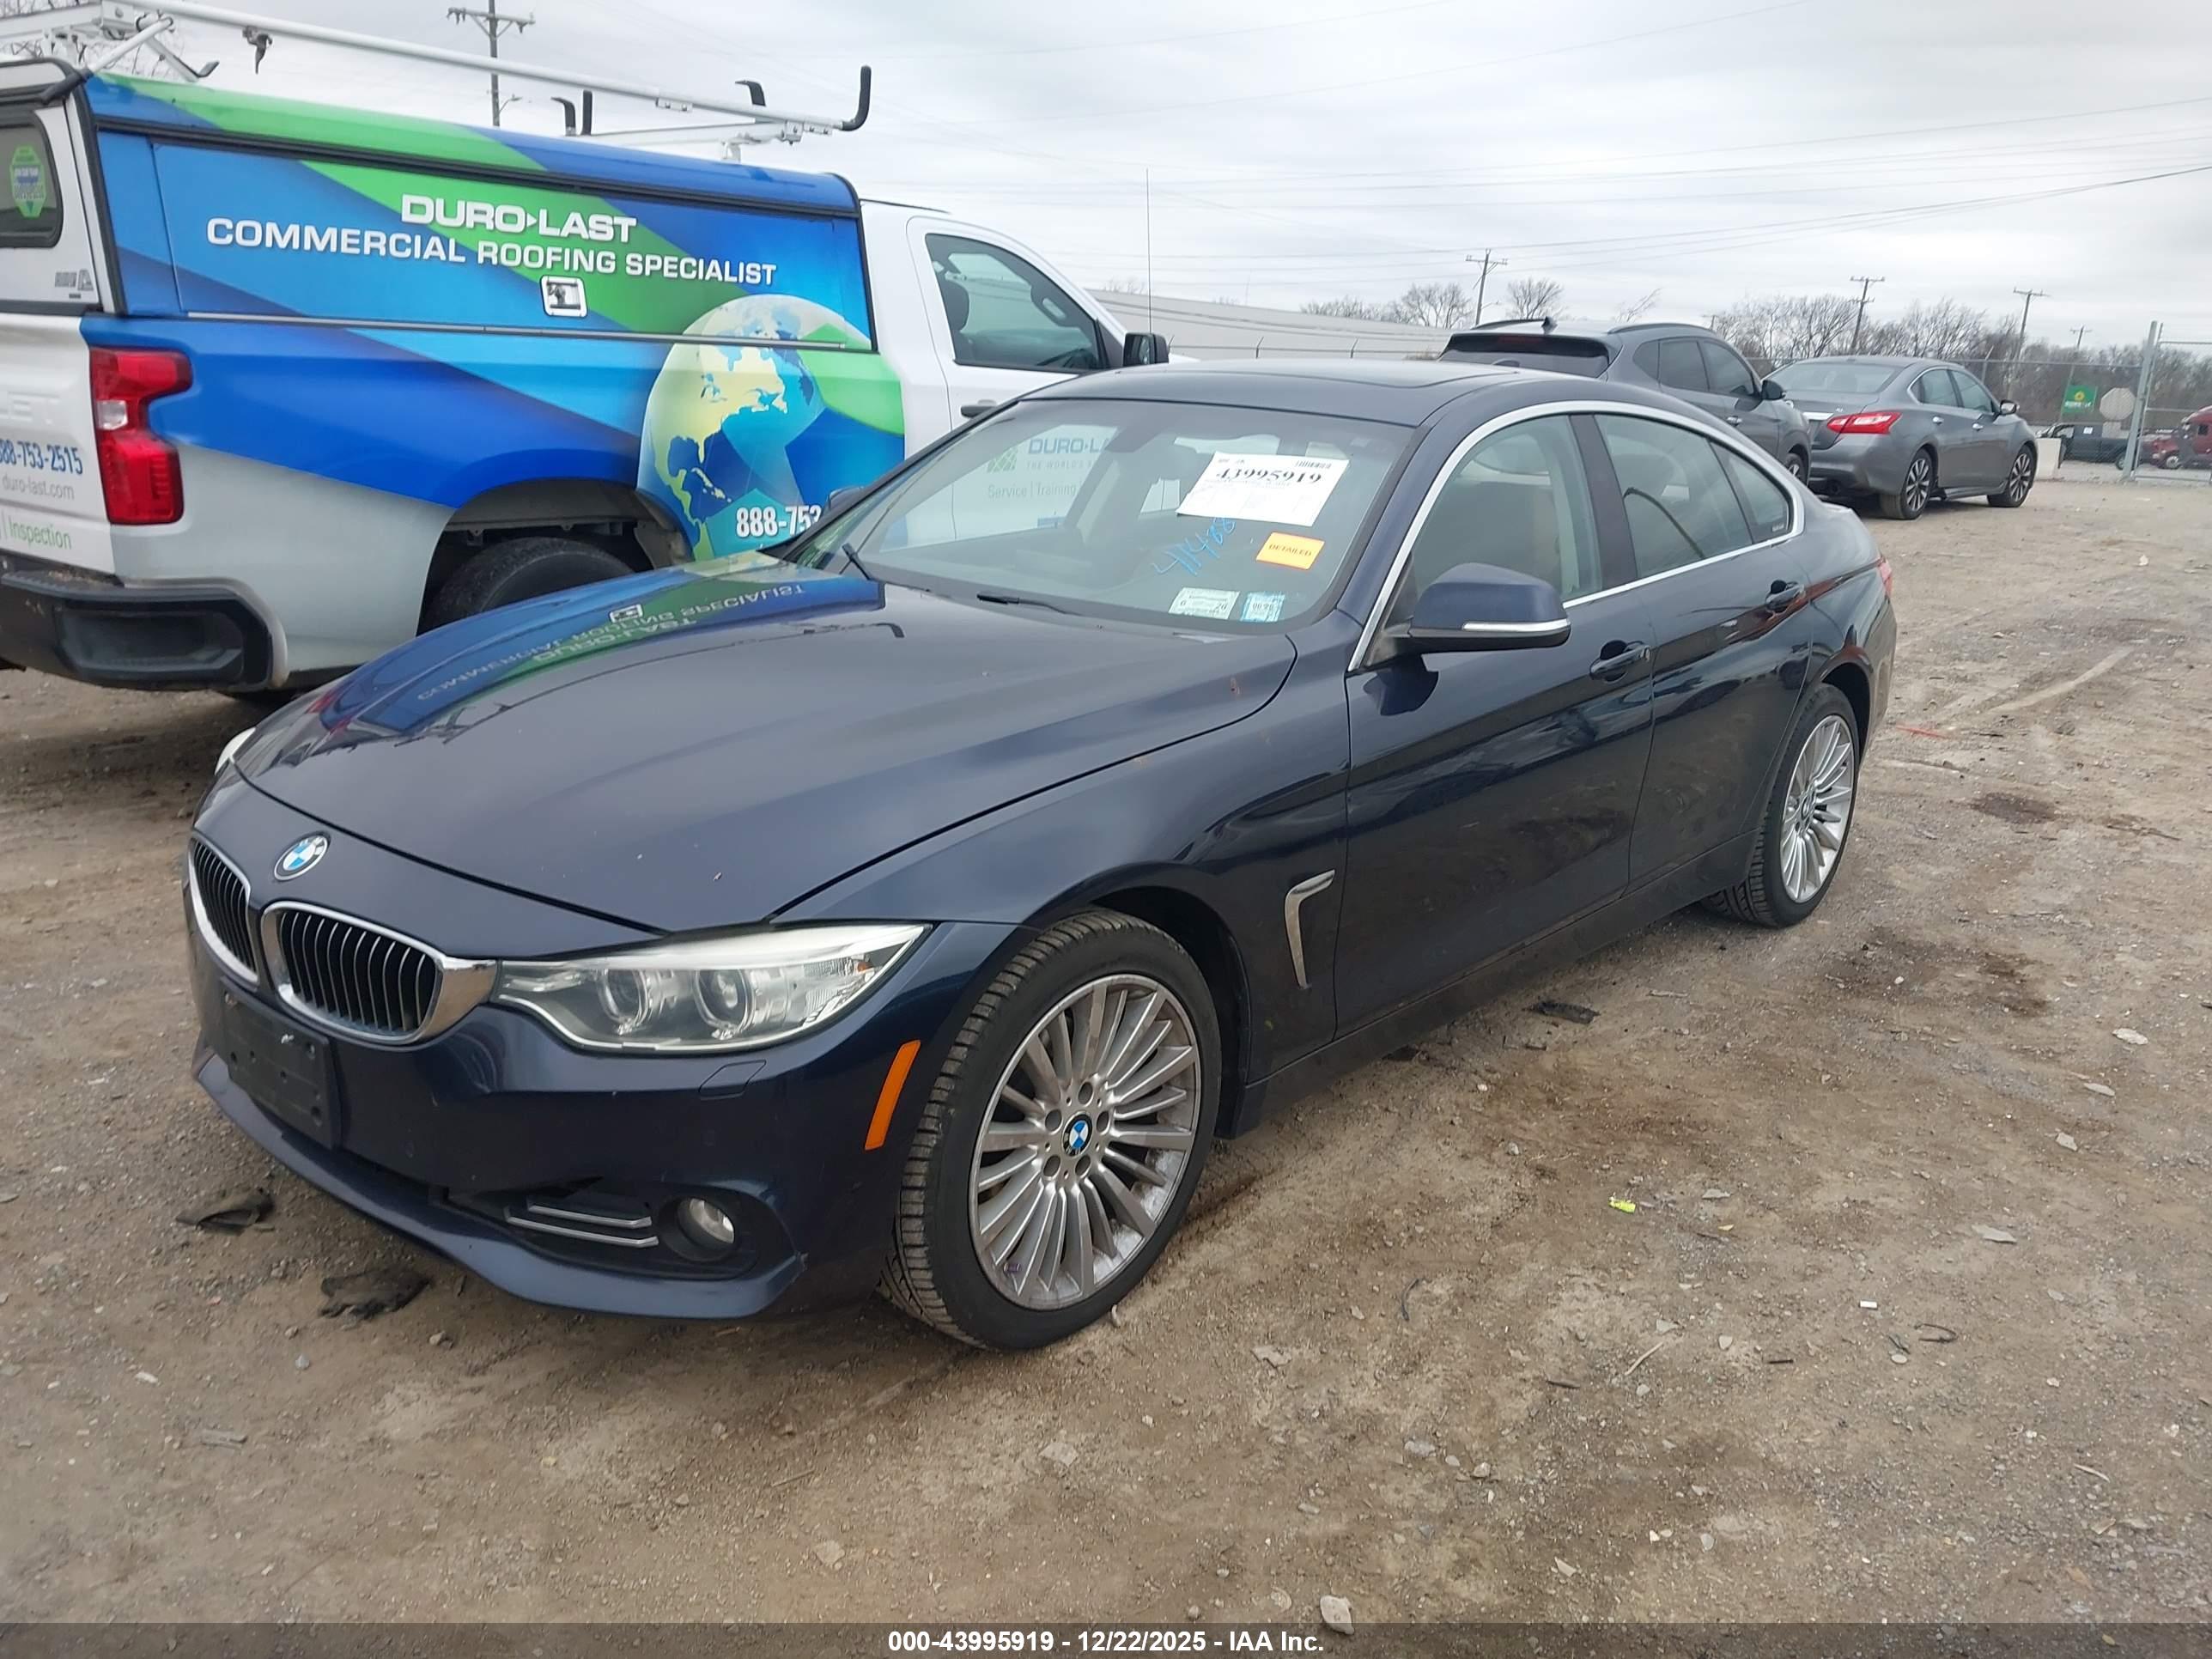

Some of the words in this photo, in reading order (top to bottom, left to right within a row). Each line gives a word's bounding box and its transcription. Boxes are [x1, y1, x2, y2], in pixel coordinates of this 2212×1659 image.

[206, 216, 466, 264] COMMERCIAL
[477, 240, 617, 274] ROOFING
[625, 252, 777, 286] SPECIALIST
[1216, 467, 1322, 483] 43995919
[2, 473, 76, 500] duro-last.com
[988, 483, 1028, 498] Service
[1036, 480, 1078, 495] Training
[9, 515, 72, 550] Inspection
[1268, 543, 1313, 557] DETAILED
